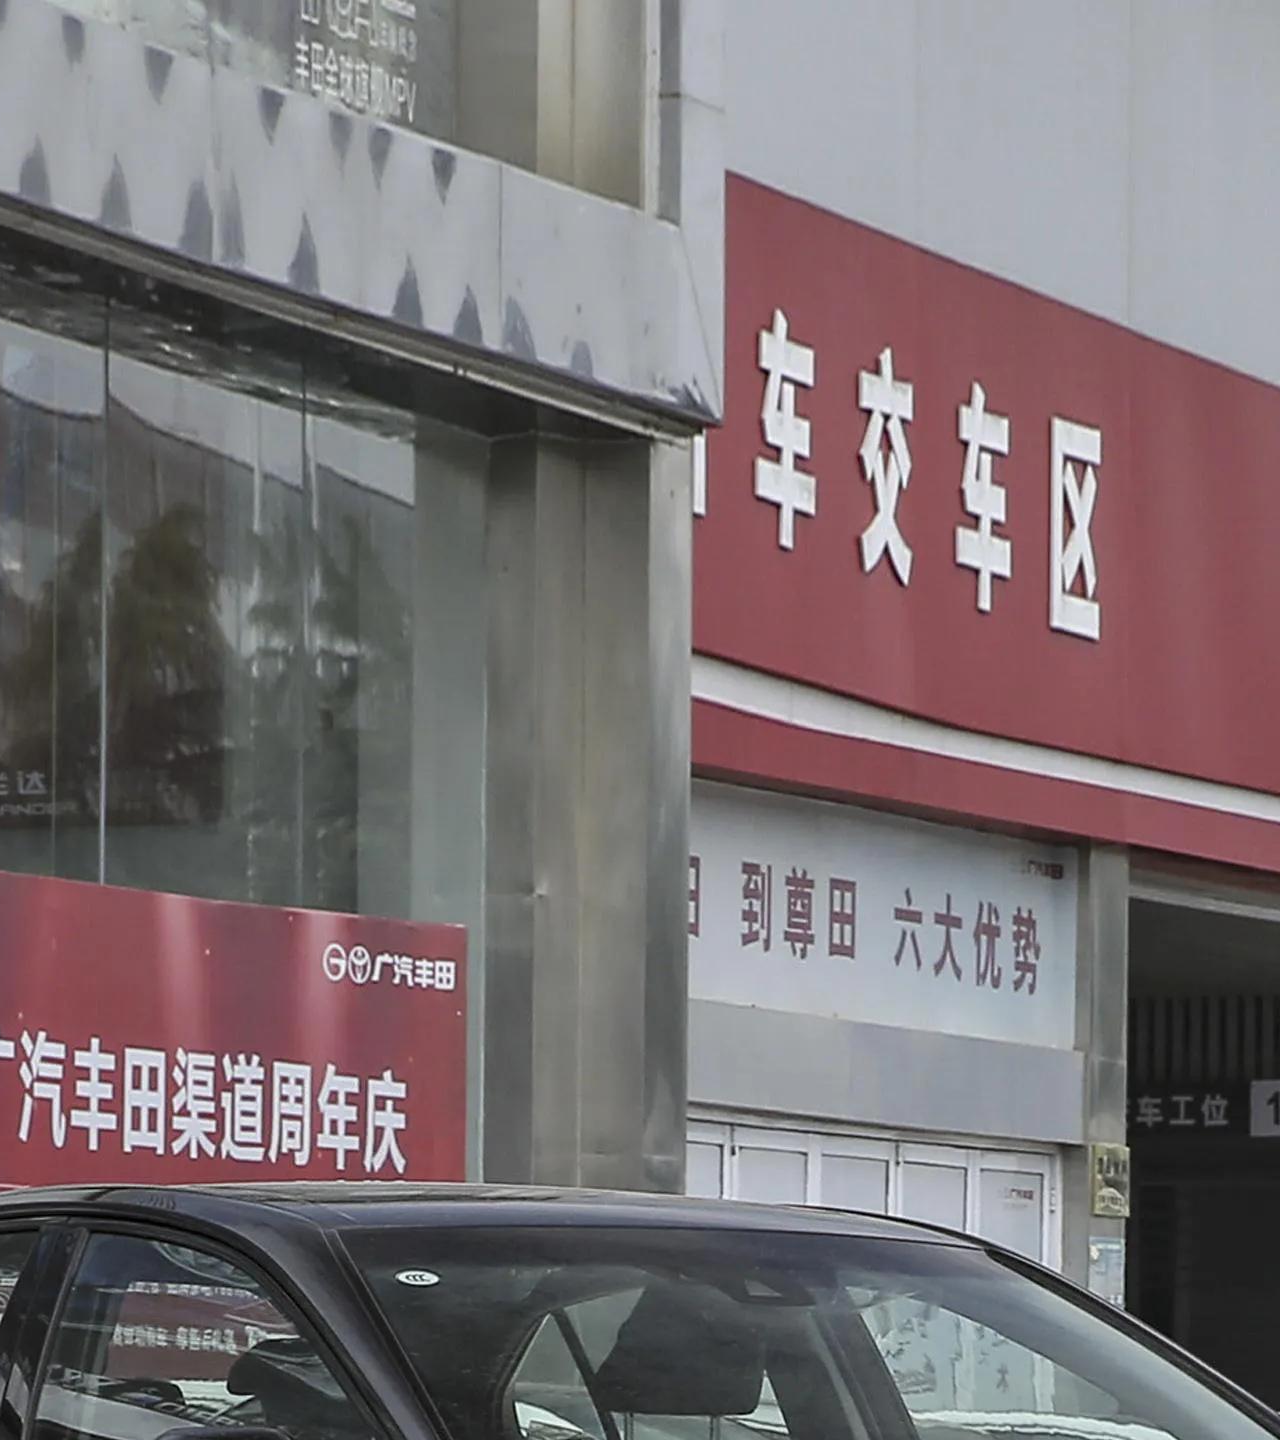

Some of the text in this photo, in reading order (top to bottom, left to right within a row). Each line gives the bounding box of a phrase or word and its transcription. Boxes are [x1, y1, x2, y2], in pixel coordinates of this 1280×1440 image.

[692, 308, 1102, 642] 车交车区
[371, 952, 457, 991] 广汽丰田
[741, 860, 858, 961] 到尊田
[893, 886, 1043, 997] 六大优势
[1125, 1094, 1230, 1128] 车工位
